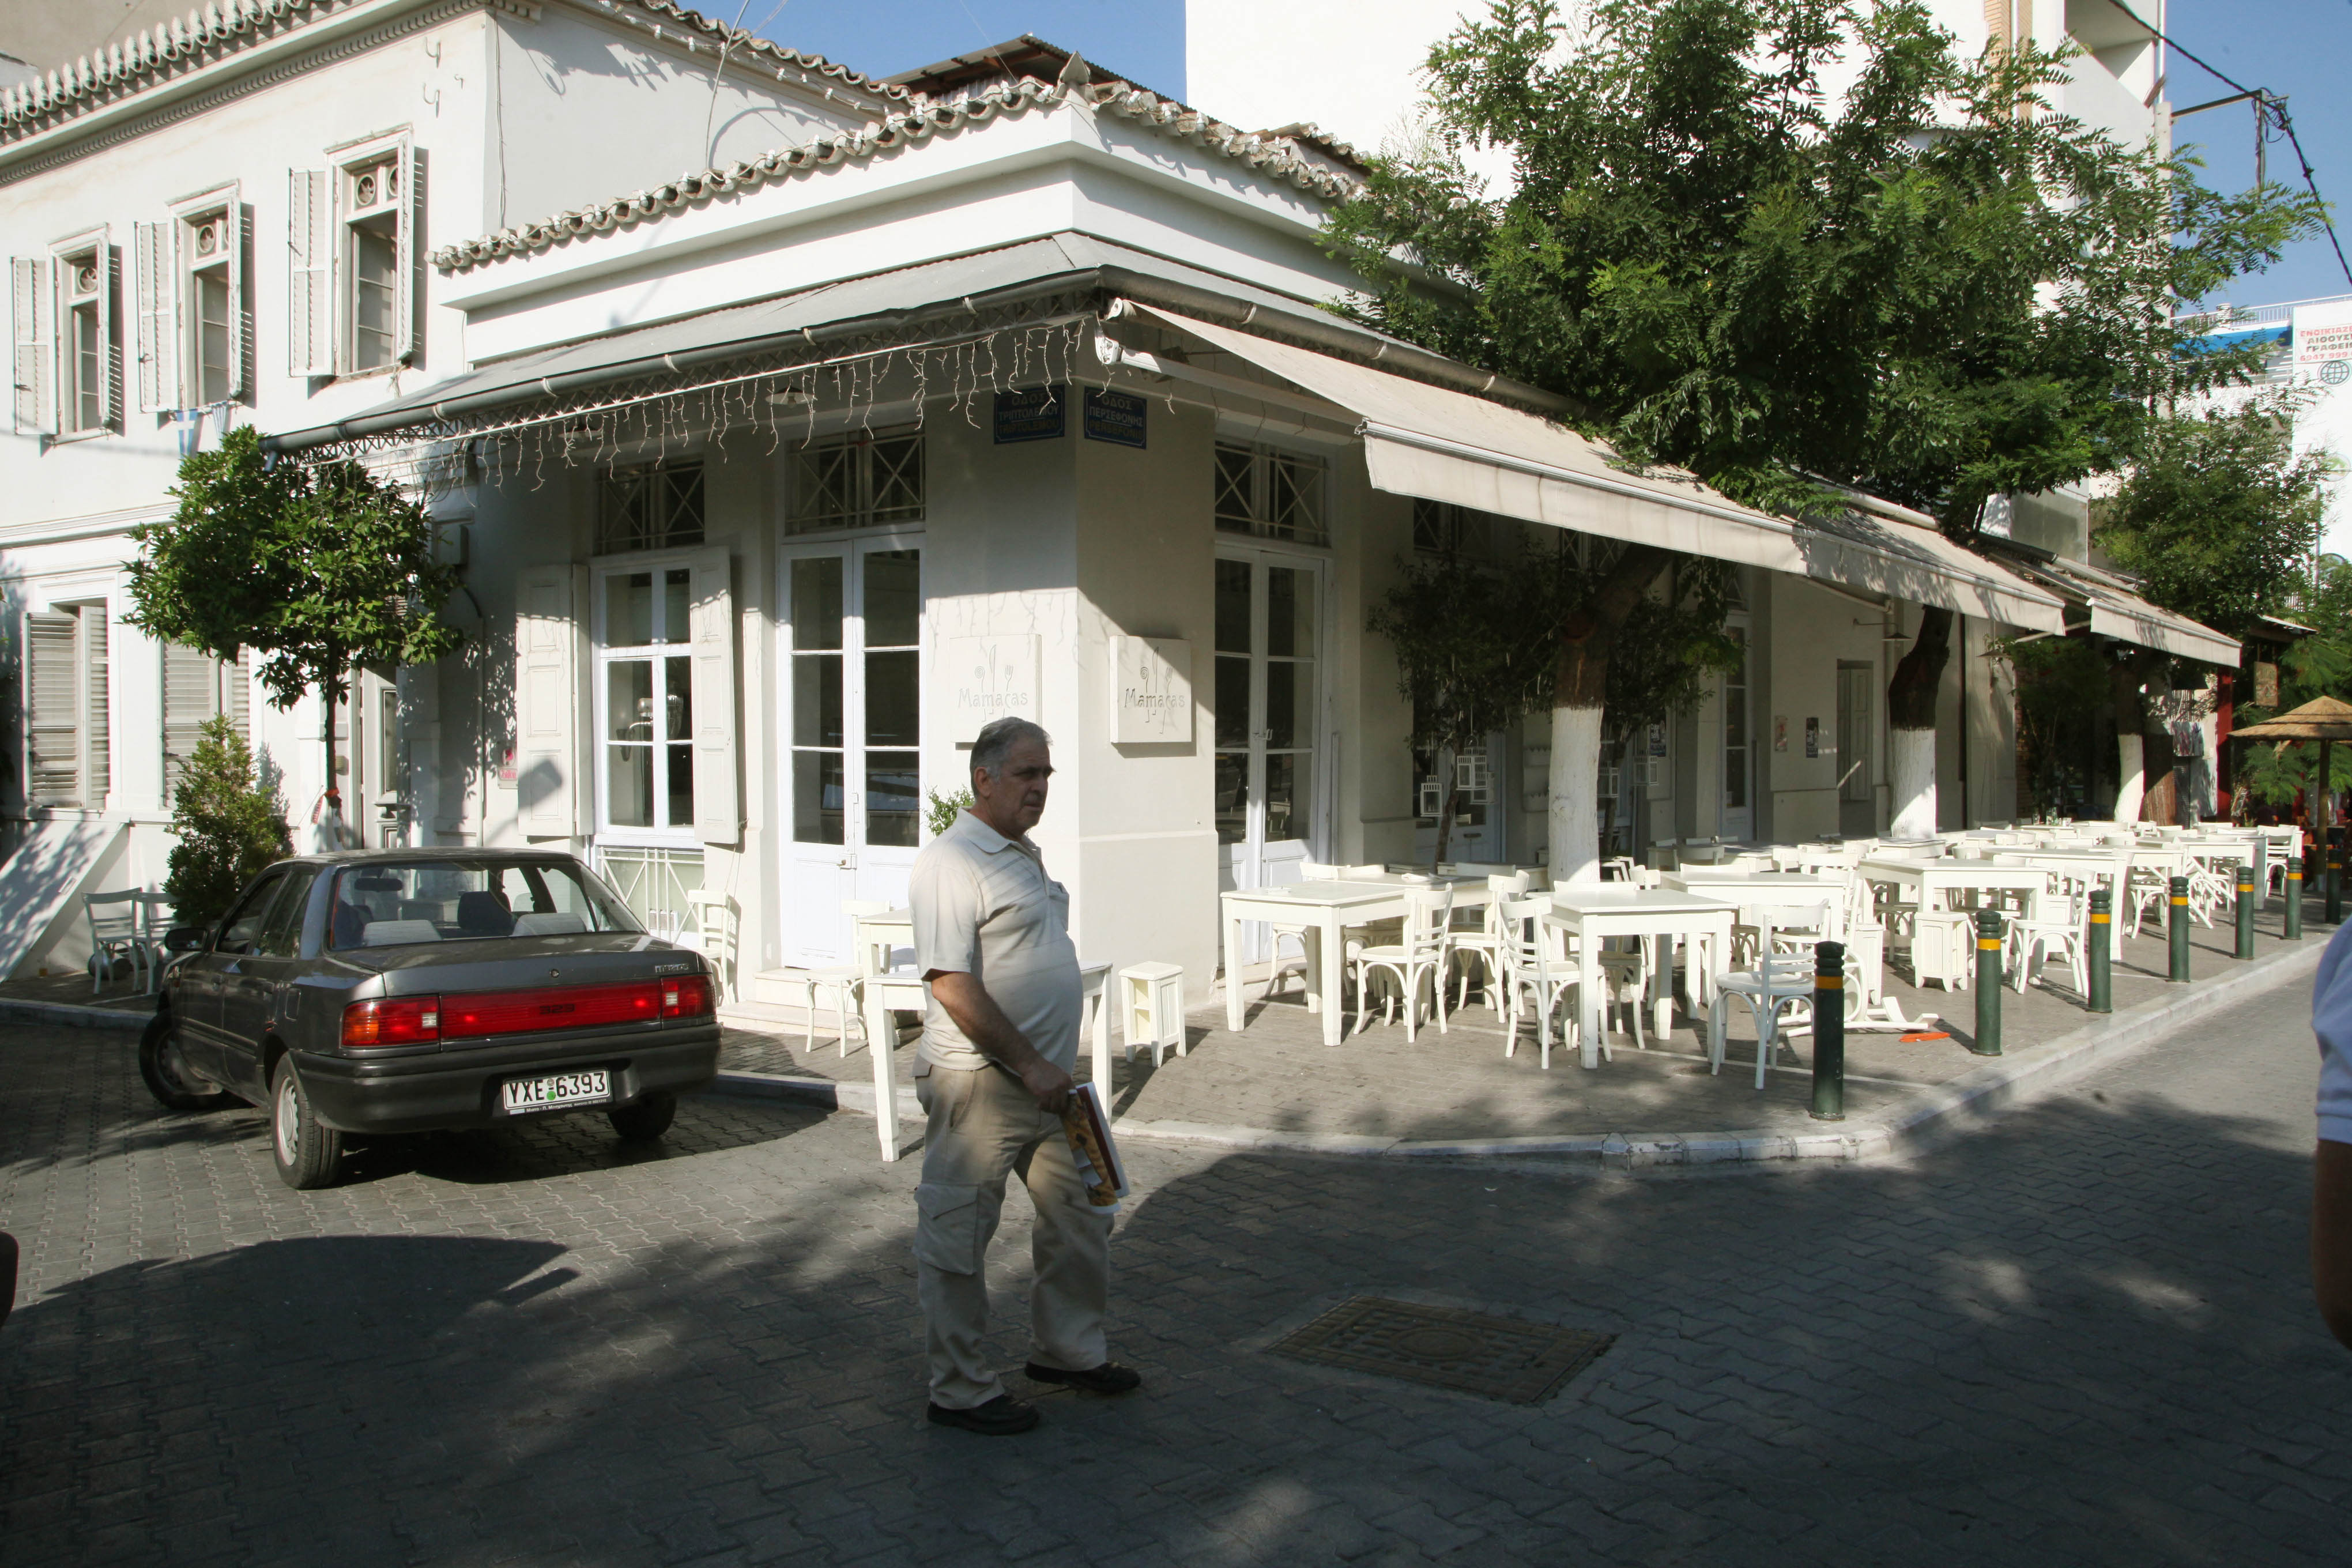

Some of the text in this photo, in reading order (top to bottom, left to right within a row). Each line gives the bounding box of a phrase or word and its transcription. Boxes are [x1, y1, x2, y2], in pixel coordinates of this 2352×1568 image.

[2308, 334, 2352, 344] ΑΙΘΟΥΣ
[1012, 393, 1046, 406] ΟΔΟΣ
[1102, 395, 1132, 410] ΟΔΟΣ
[1089, 405, 1143, 427] ΠΕΡΣΕΦΟΝΗΣ
[958, 688, 1028, 708] Mamacas
[1125, 688, 1185, 710] Mamacas
[539, 1004, 575, 1015] 323
